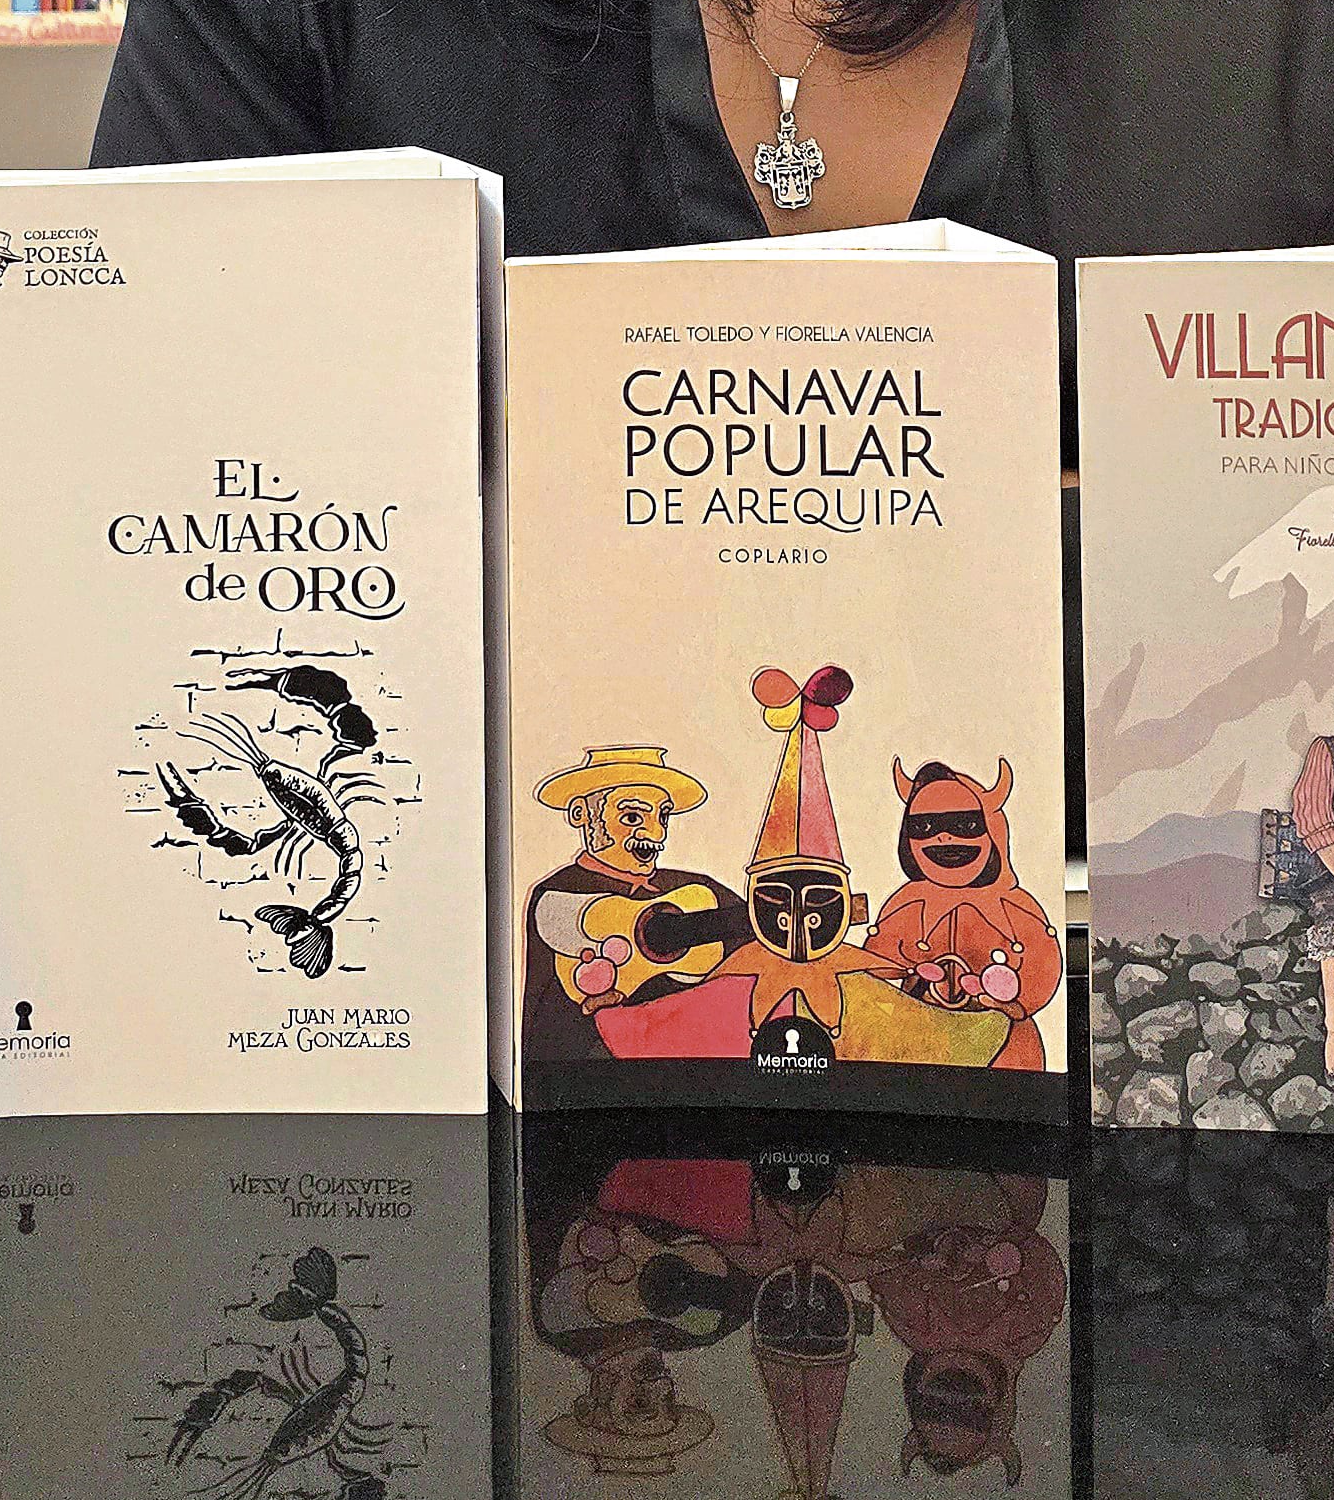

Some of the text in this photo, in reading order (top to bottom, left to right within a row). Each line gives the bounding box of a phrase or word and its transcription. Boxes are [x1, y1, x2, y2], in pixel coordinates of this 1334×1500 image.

[24, 228, 99, 240] COLECCIÓN
[24, 242, 108, 264] POESÍA
[24, 268, 126, 287] LONCCA
[624, 326, 934, 343] RAFAEL TOLEDO Y FIORELLA VALENCIA
[623, 368, 942, 417] CARNAVAL
[626, 423, 945, 479] POPULAR
[1221, 455, 1279, 475] PARA
[213, 459, 300, 502] EL
[626, 487, 944, 534] DE AREQUIPA
[108, 502, 398, 555] CAMARÓN
[718, 549, 829, 564] COPLARIO
[185, 562, 406, 620] de ORO
[281, 1008, 410, 1029] JUAN MARIO
[227, 1027, 411, 1053] MEZA GONZALES
[757, 1053, 828, 1069] Memoria
